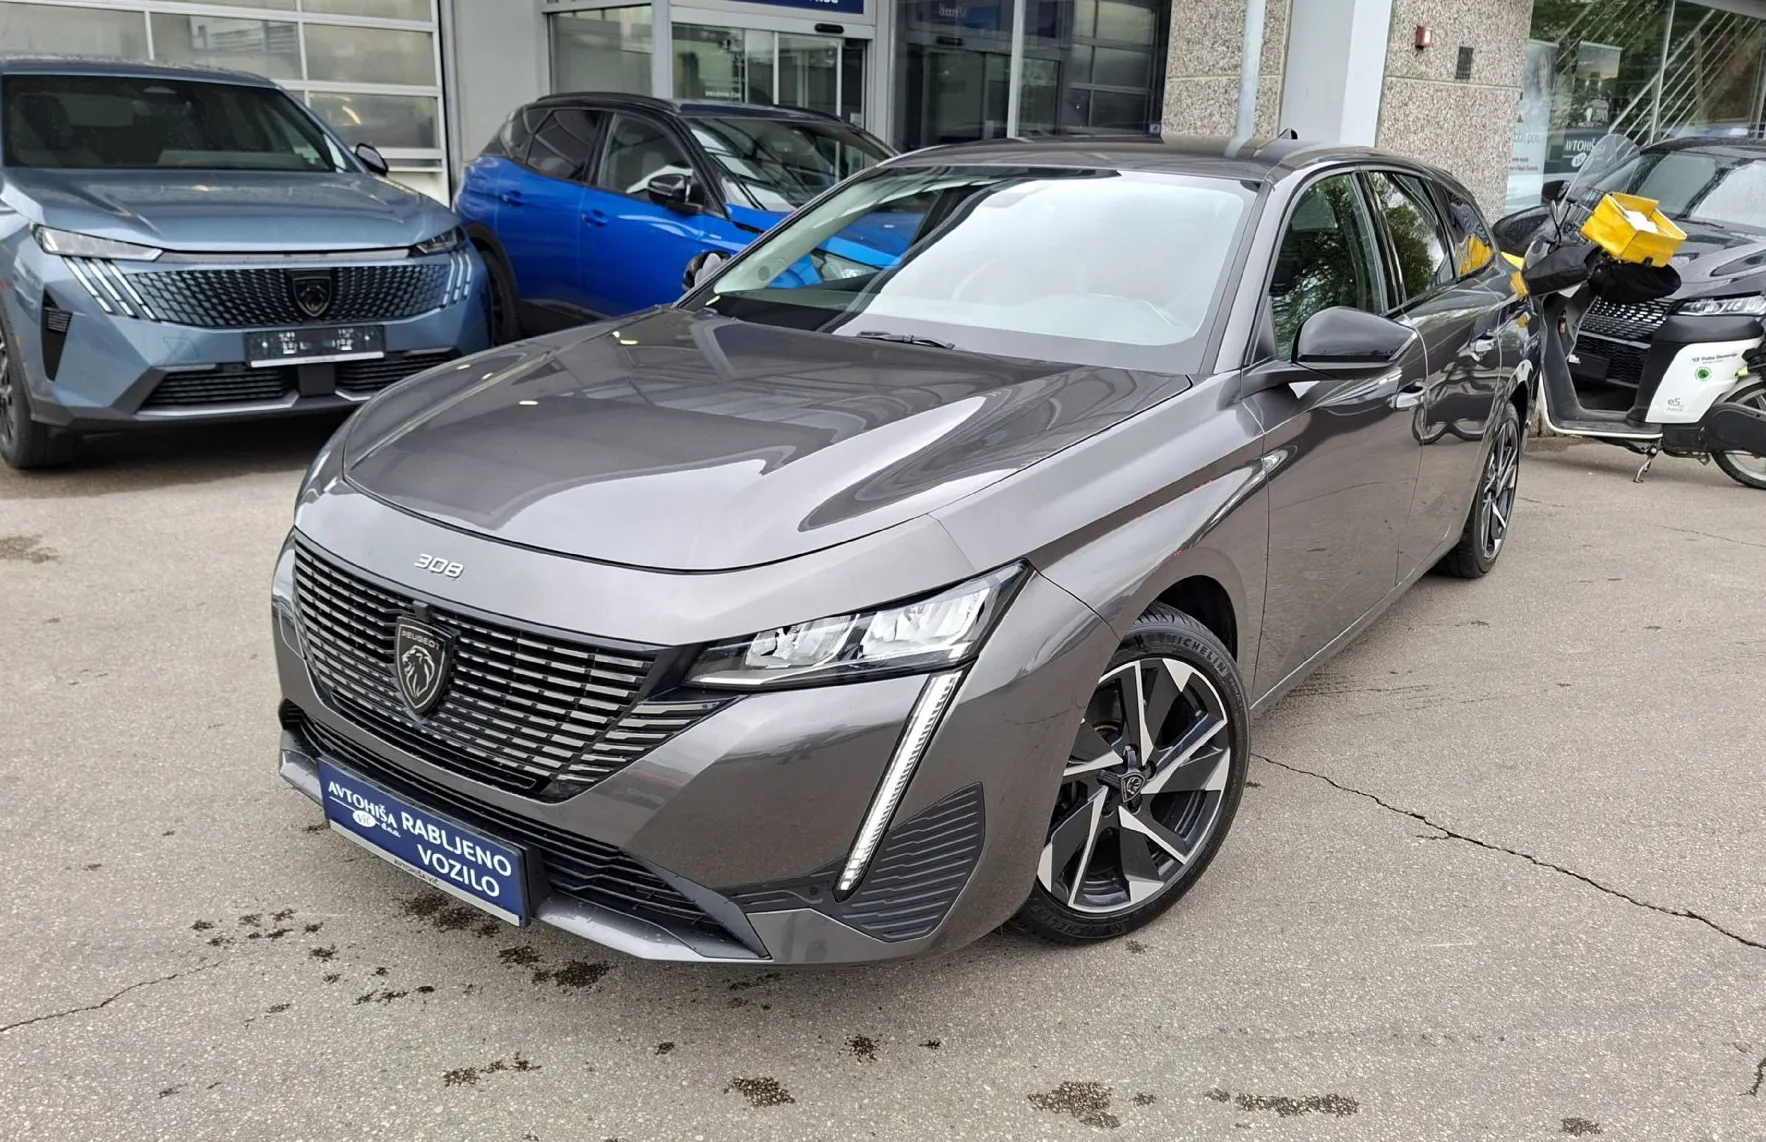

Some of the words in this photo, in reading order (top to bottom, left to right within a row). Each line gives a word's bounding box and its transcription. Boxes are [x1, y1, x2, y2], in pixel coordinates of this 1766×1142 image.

[414, 553, 464, 578] 308
[402, 630, 440, 650] PEUGEOT
[1166, 633, 1228, 674] MICHELIN
[328, 781, 398, 829] AVTOHIŠA
[400, 811, 512, 877] RABLJENO
[417, 844, 500, 897] VOZILO
